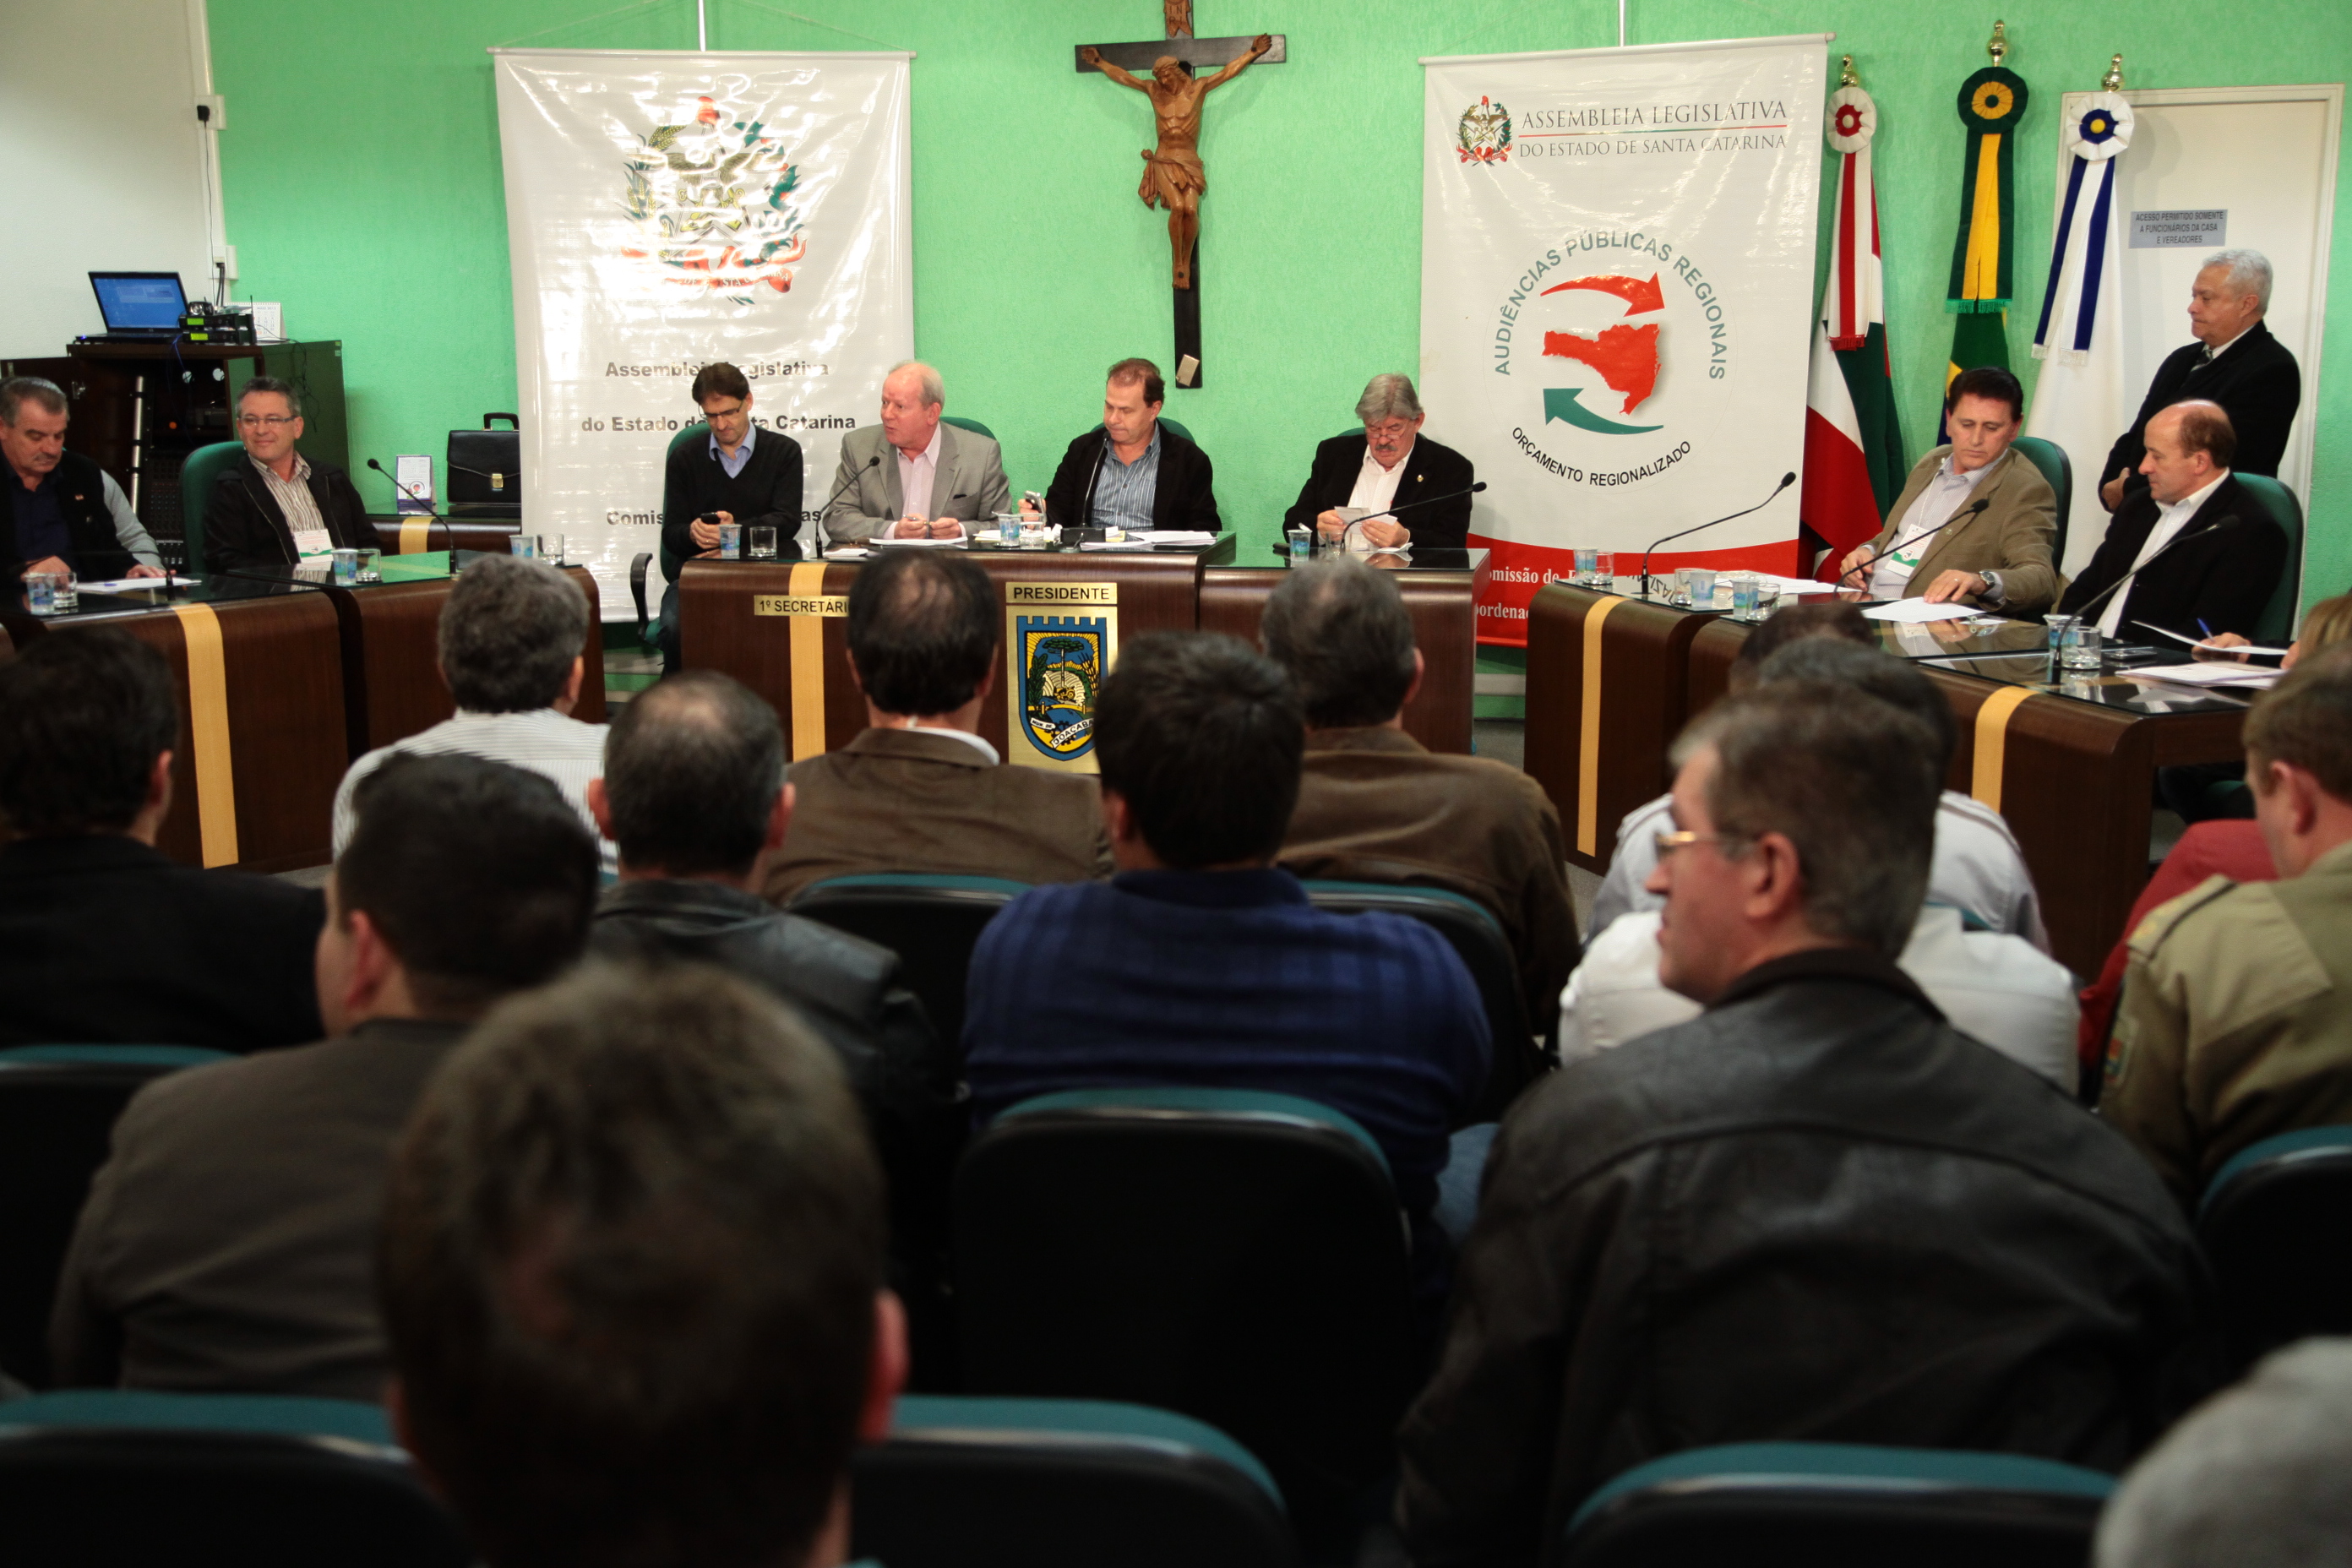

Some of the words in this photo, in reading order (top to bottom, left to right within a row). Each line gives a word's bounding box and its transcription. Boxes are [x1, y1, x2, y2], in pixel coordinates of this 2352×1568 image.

[1522, 107, 1645, 129] ASSEMBLEIA
[1652, 101, 1788, 124] LEGISLATIVA
[1520, 144, 1544, 157] DO
[1549, 140, 1609, 156] ESTADO
[1616, 140, 1636, 155] DE
[1642, 138, 1696, 154] SANTA
[1701, 134, 1787, 151] CATARINA
[2136, 213, 2160, 221] ACESSO
[2161, 212, 2193, 221] PERMITIDO
[2194, 211, 2224, 220] SOMENTE
[2145, 223, 2190, 232] FUNCIONÁRIOS
[2191, 224, 2200, 232] DA
[2201, 223, 2218, 231] CASA
[1494, 249, 1561, 376] AUDIÊNCIAS
[1565, 230, 1672, 262] PÚBLICAS
[1673, 255, 1728, 380] REGIONAIS
[605, 362, 705, 378] Assemble
[581, 417, 605, 433] do
[612, 416, 678, 433] Estado
[776, 414, 856, 430] Catarina
[1512, 427, 1583, 482] ORÇAMENTO
[1590, 441, 1690, 487] REGIONALIZADO
[607, 510, 663, 525] Comis
[1489, 566, 1539, 583] missão
[1013, 587, 1110, 599] PRESIDENTE
[760, 600, 770, 612] 1º
[774, 598, 847, 612] SECRETÁRI
